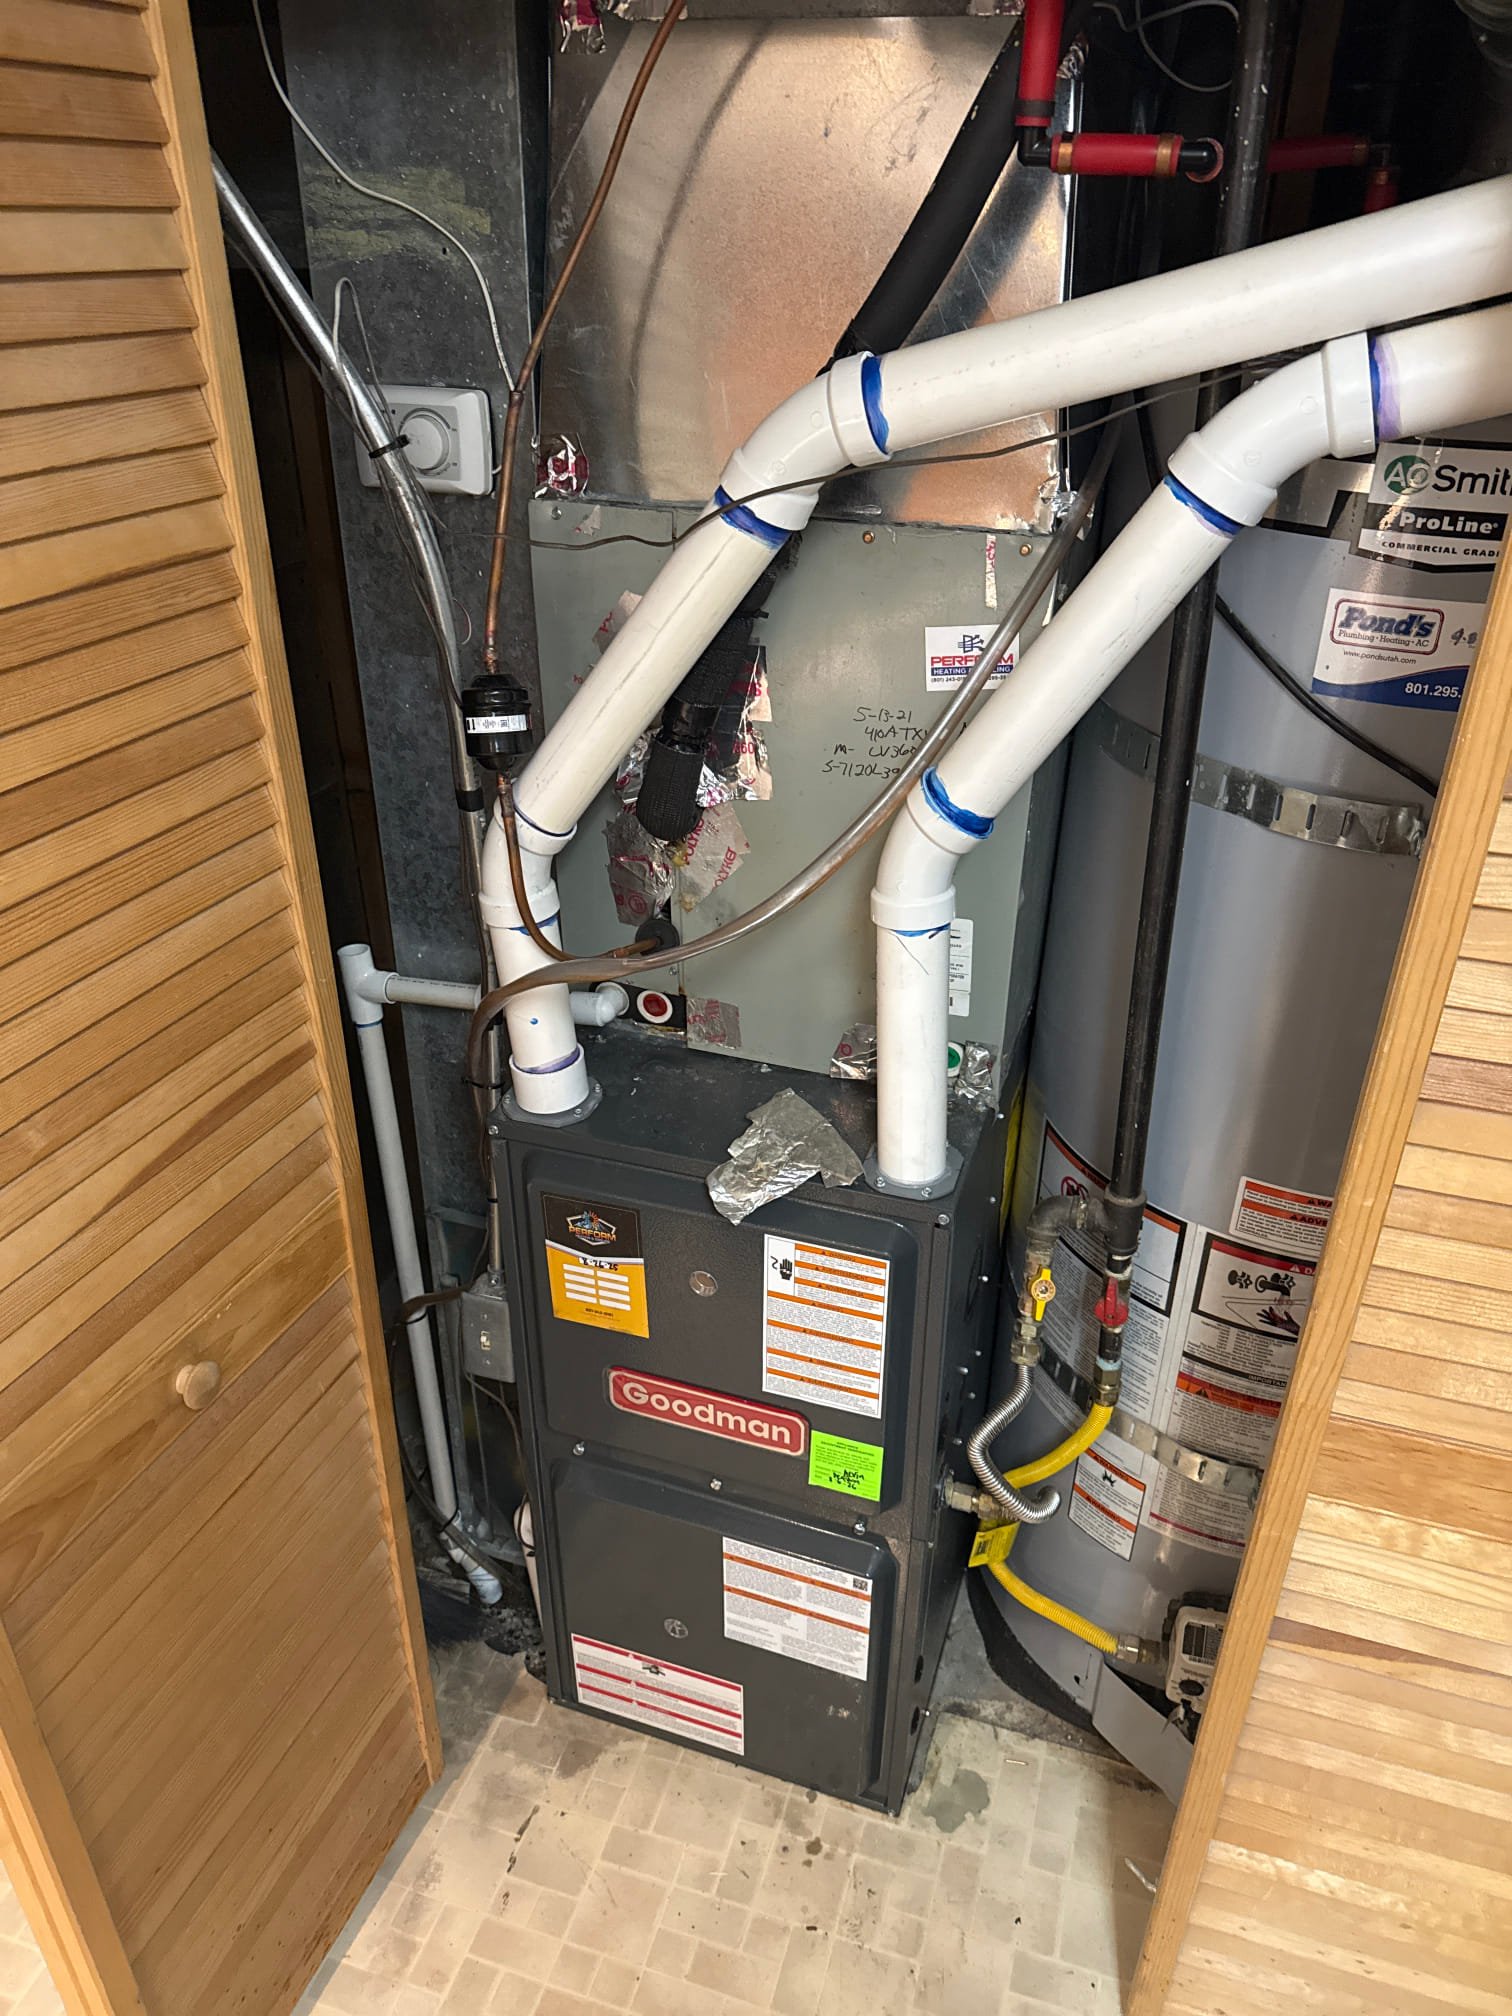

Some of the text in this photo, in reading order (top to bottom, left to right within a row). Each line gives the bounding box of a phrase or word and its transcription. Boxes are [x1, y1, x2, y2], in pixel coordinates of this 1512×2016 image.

[1432, 464, 1512, 496] Smit
[1381, 541, 1457, 555] COMMERCIAL
[1338, 606, 1436, 638] Pond's
[1338, 630, 1430, 647] Plumbing Heating AC
[1343, 649, 1417, 664] www.pondsutah.com
[933, 667, 967, 675] HEATING
[568, 1225, 617, 1242] PERFORM
[622, 1382, 792, 1445] Goodman
